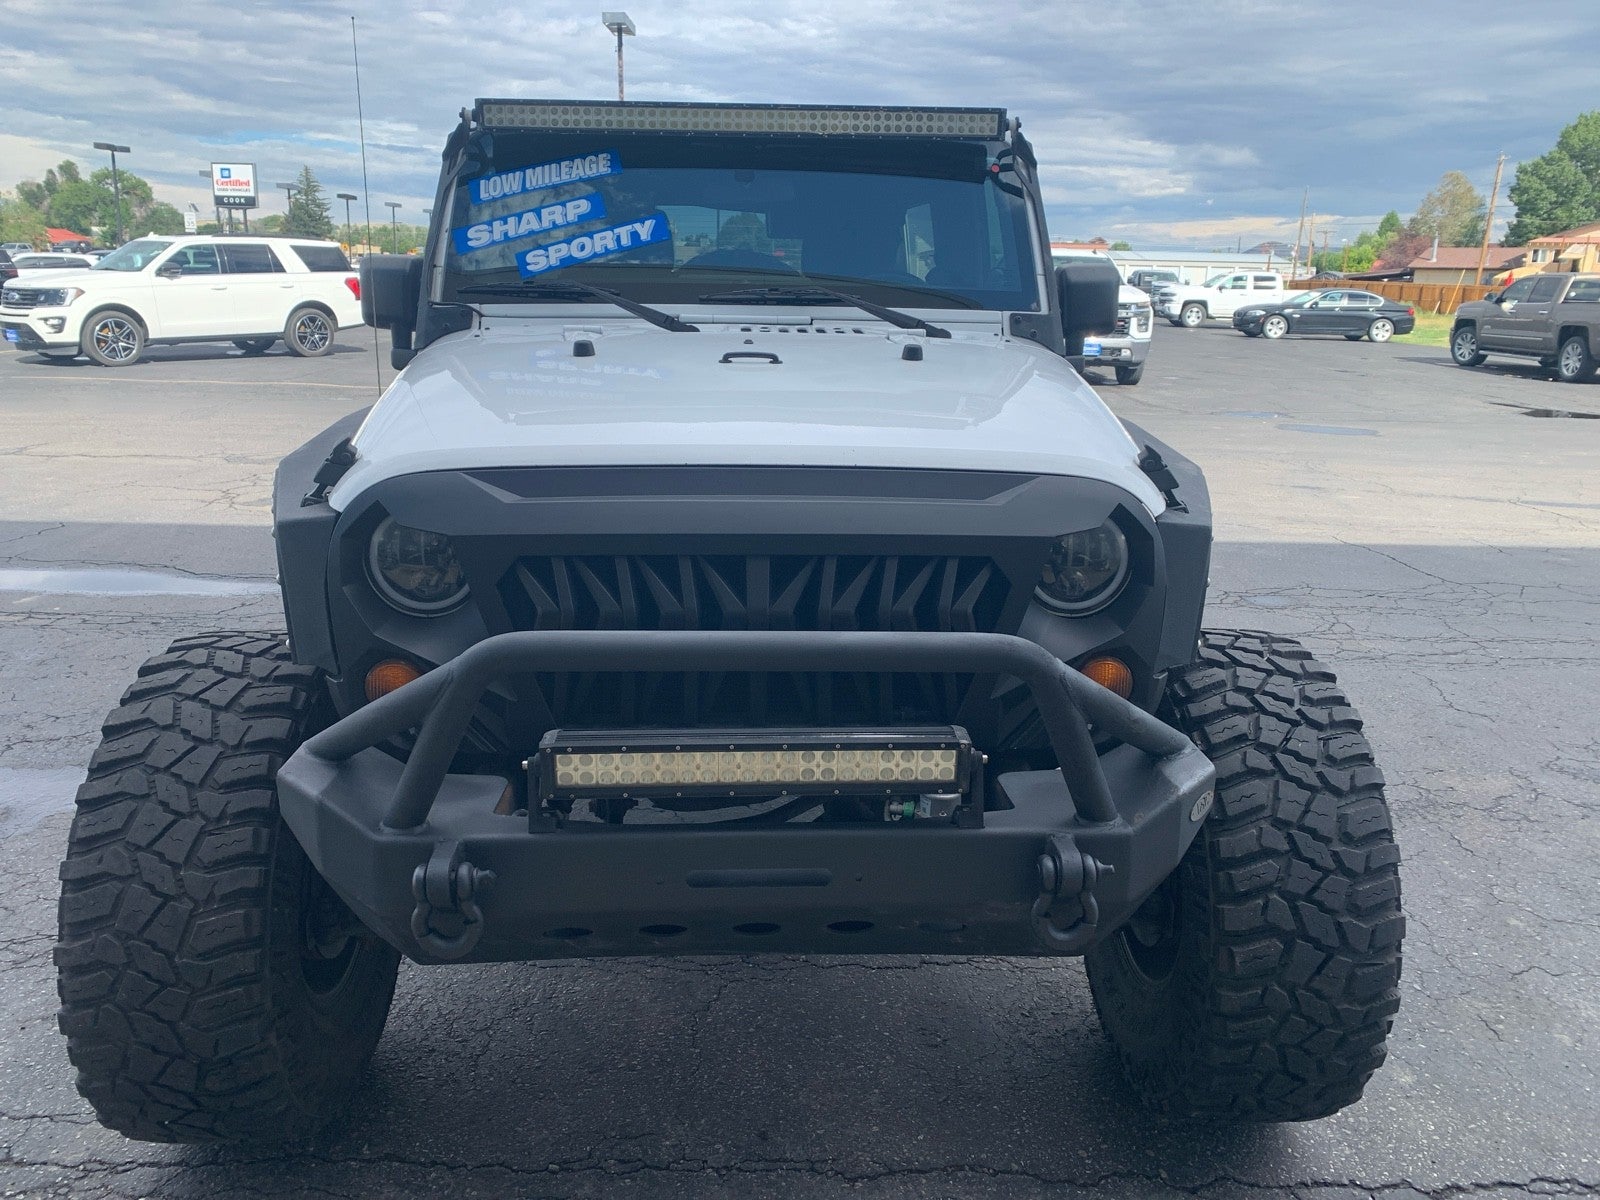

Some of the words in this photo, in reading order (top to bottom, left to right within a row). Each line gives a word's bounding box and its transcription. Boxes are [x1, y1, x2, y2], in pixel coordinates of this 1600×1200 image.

[216, 178, 250, 187] Certified
[479, 171, 523, 200] LOW
[525, 152, 612, 189] MILEAGE
[467, 199, 592, 248] SHARP
[525, 219, 656, 272] SPORTY
